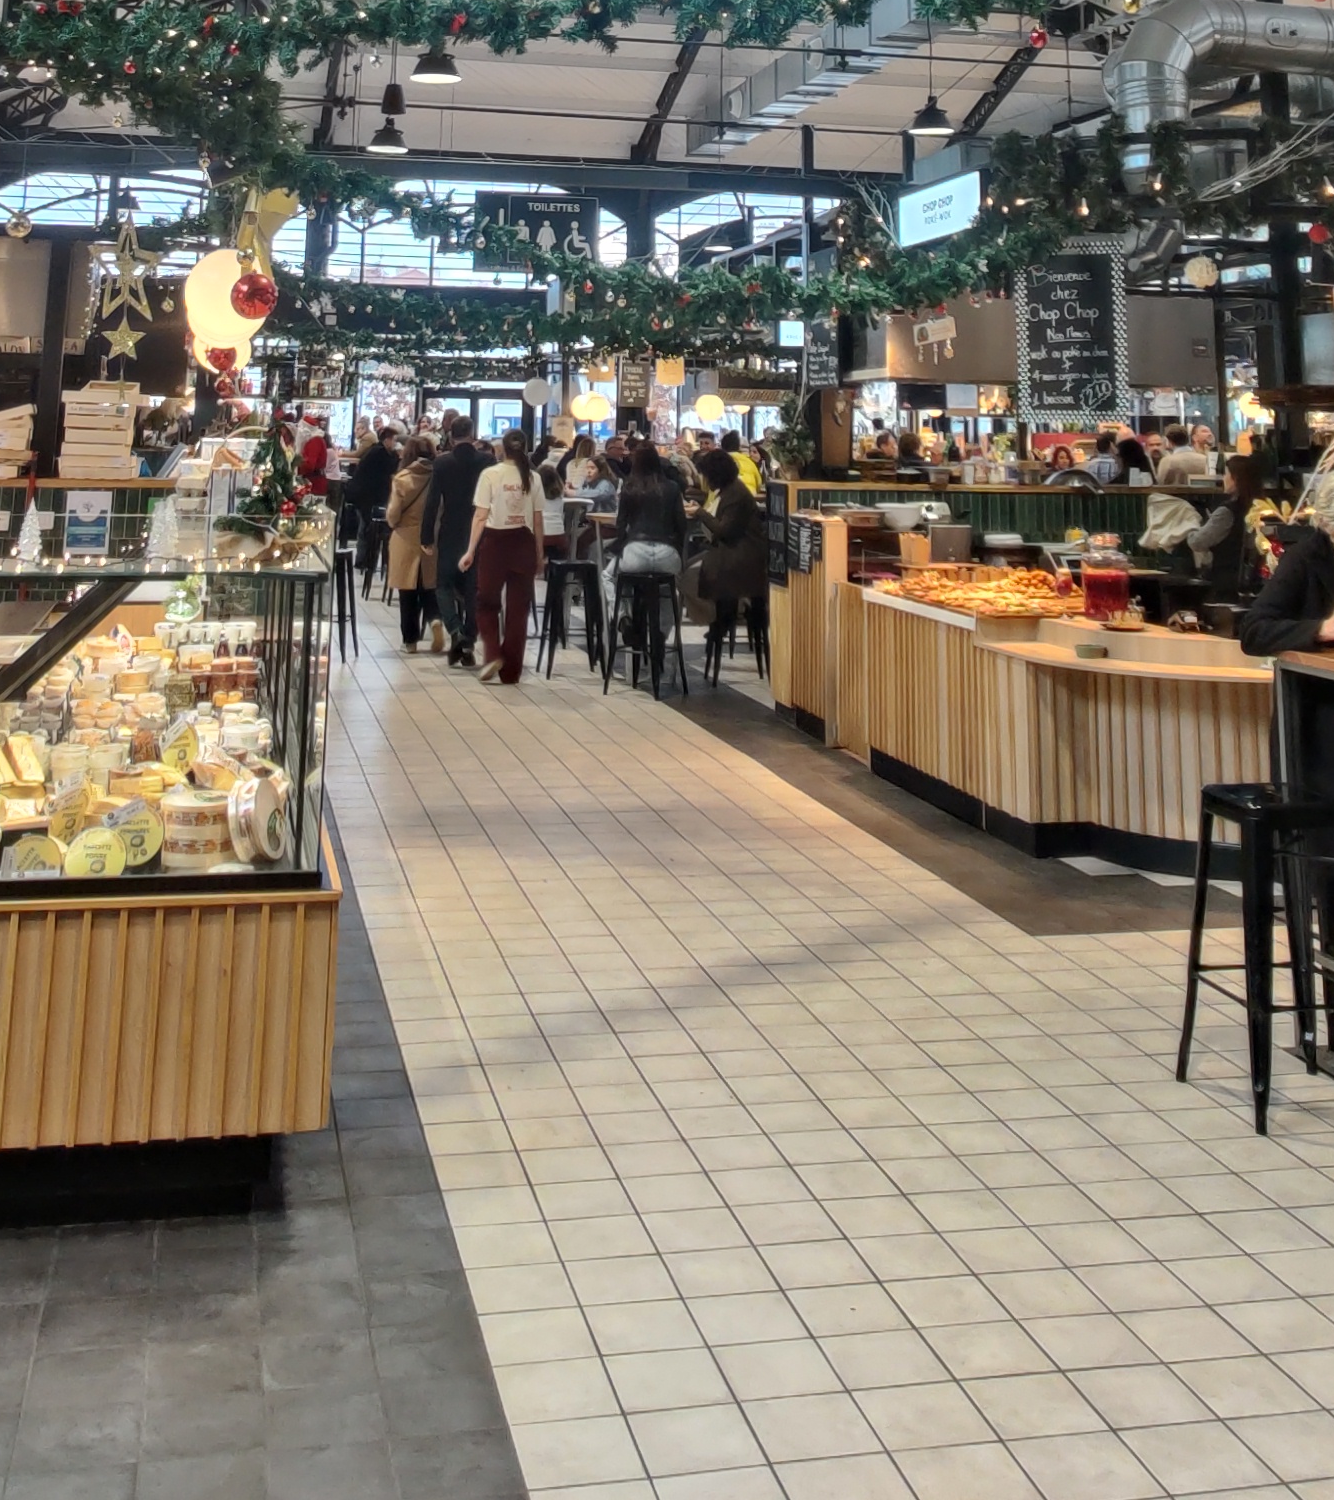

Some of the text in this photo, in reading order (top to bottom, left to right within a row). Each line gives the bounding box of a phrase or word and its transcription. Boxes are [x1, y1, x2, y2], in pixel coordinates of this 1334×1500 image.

[527, 202, 581, 213] TOILETTES
[938, 194, 954, 209] CHOP
[1051, 284, 1079, 300] chez
[1028, 301, 1099, 326] Chop Chop
